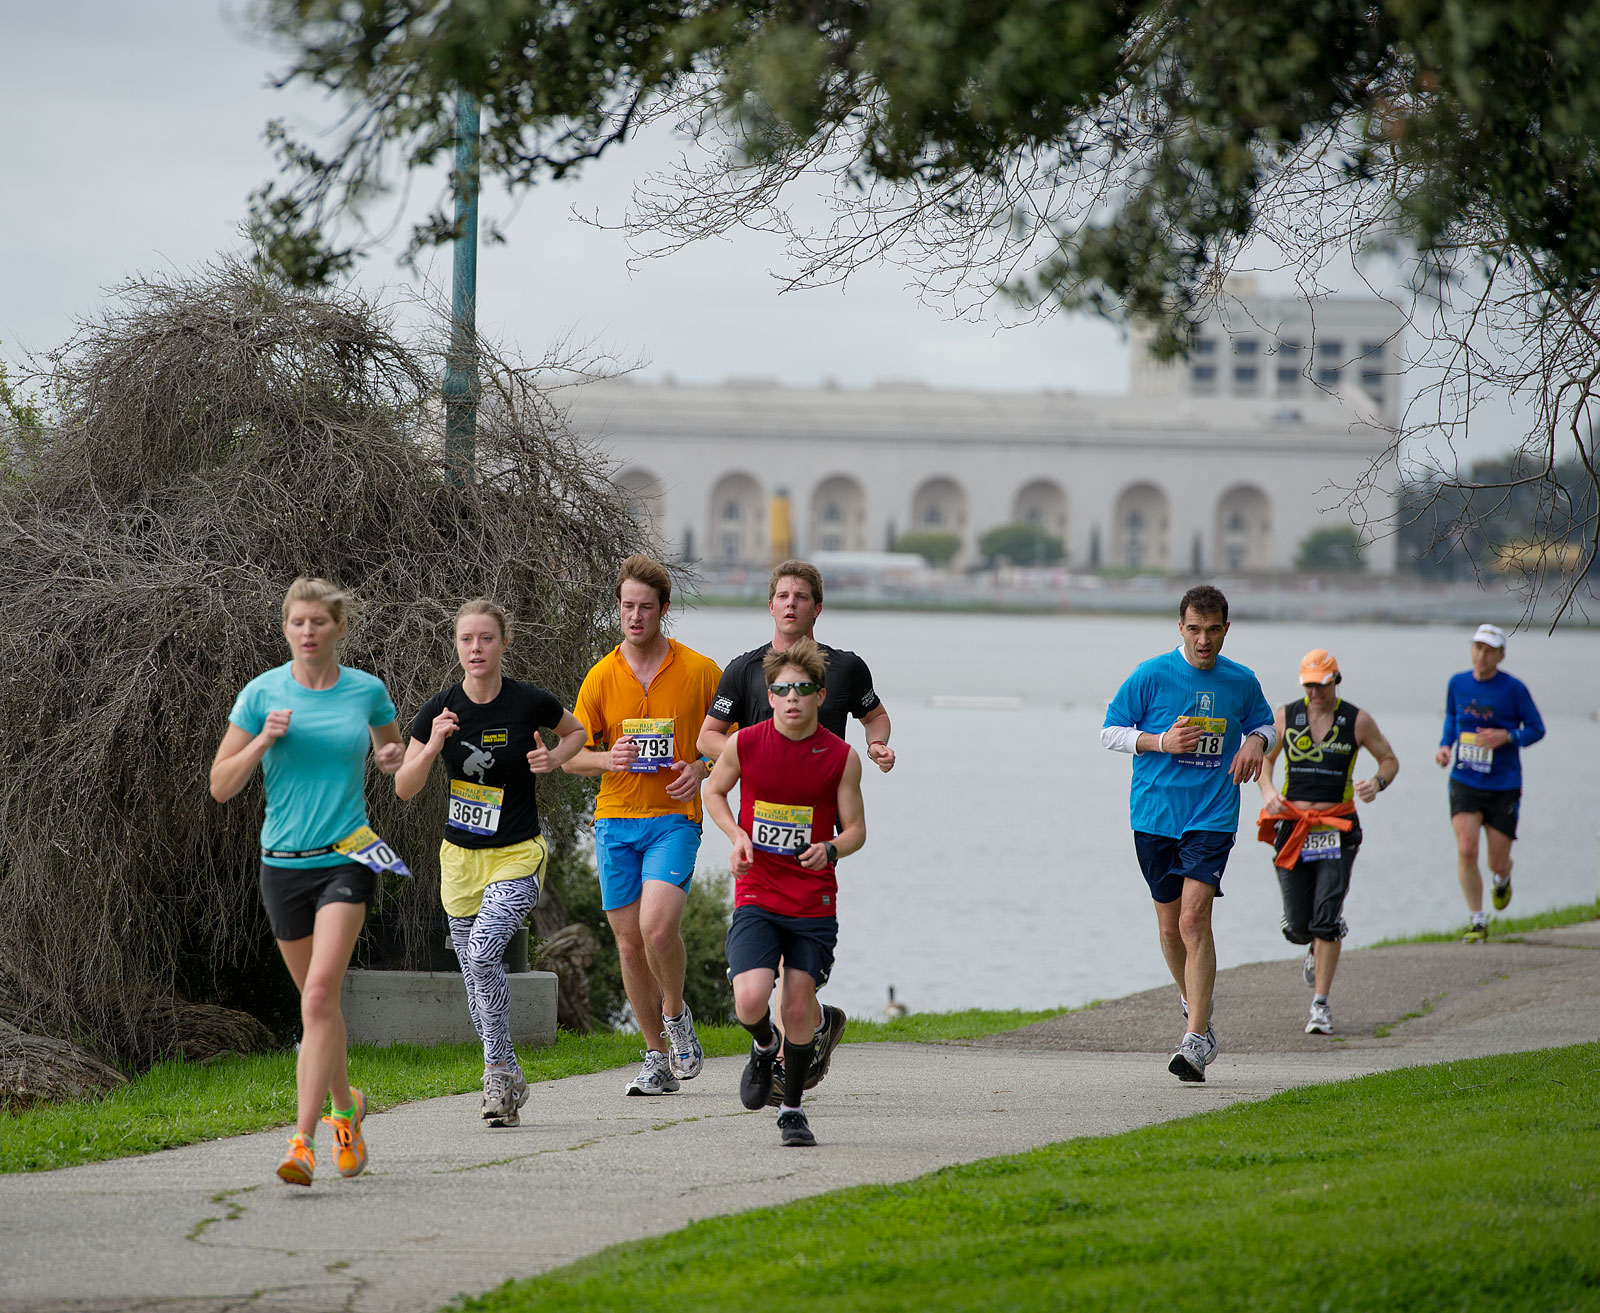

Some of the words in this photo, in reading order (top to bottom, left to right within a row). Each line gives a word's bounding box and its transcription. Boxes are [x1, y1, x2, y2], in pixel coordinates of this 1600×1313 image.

[1191, 737, 1220, 754] 18
[452, 788, 480, 800] MARATHON
[453, 801, 492, 828] 3691
[756, 810, 788, 821] MARATHON
[757, 824, 806, 848] 6275
